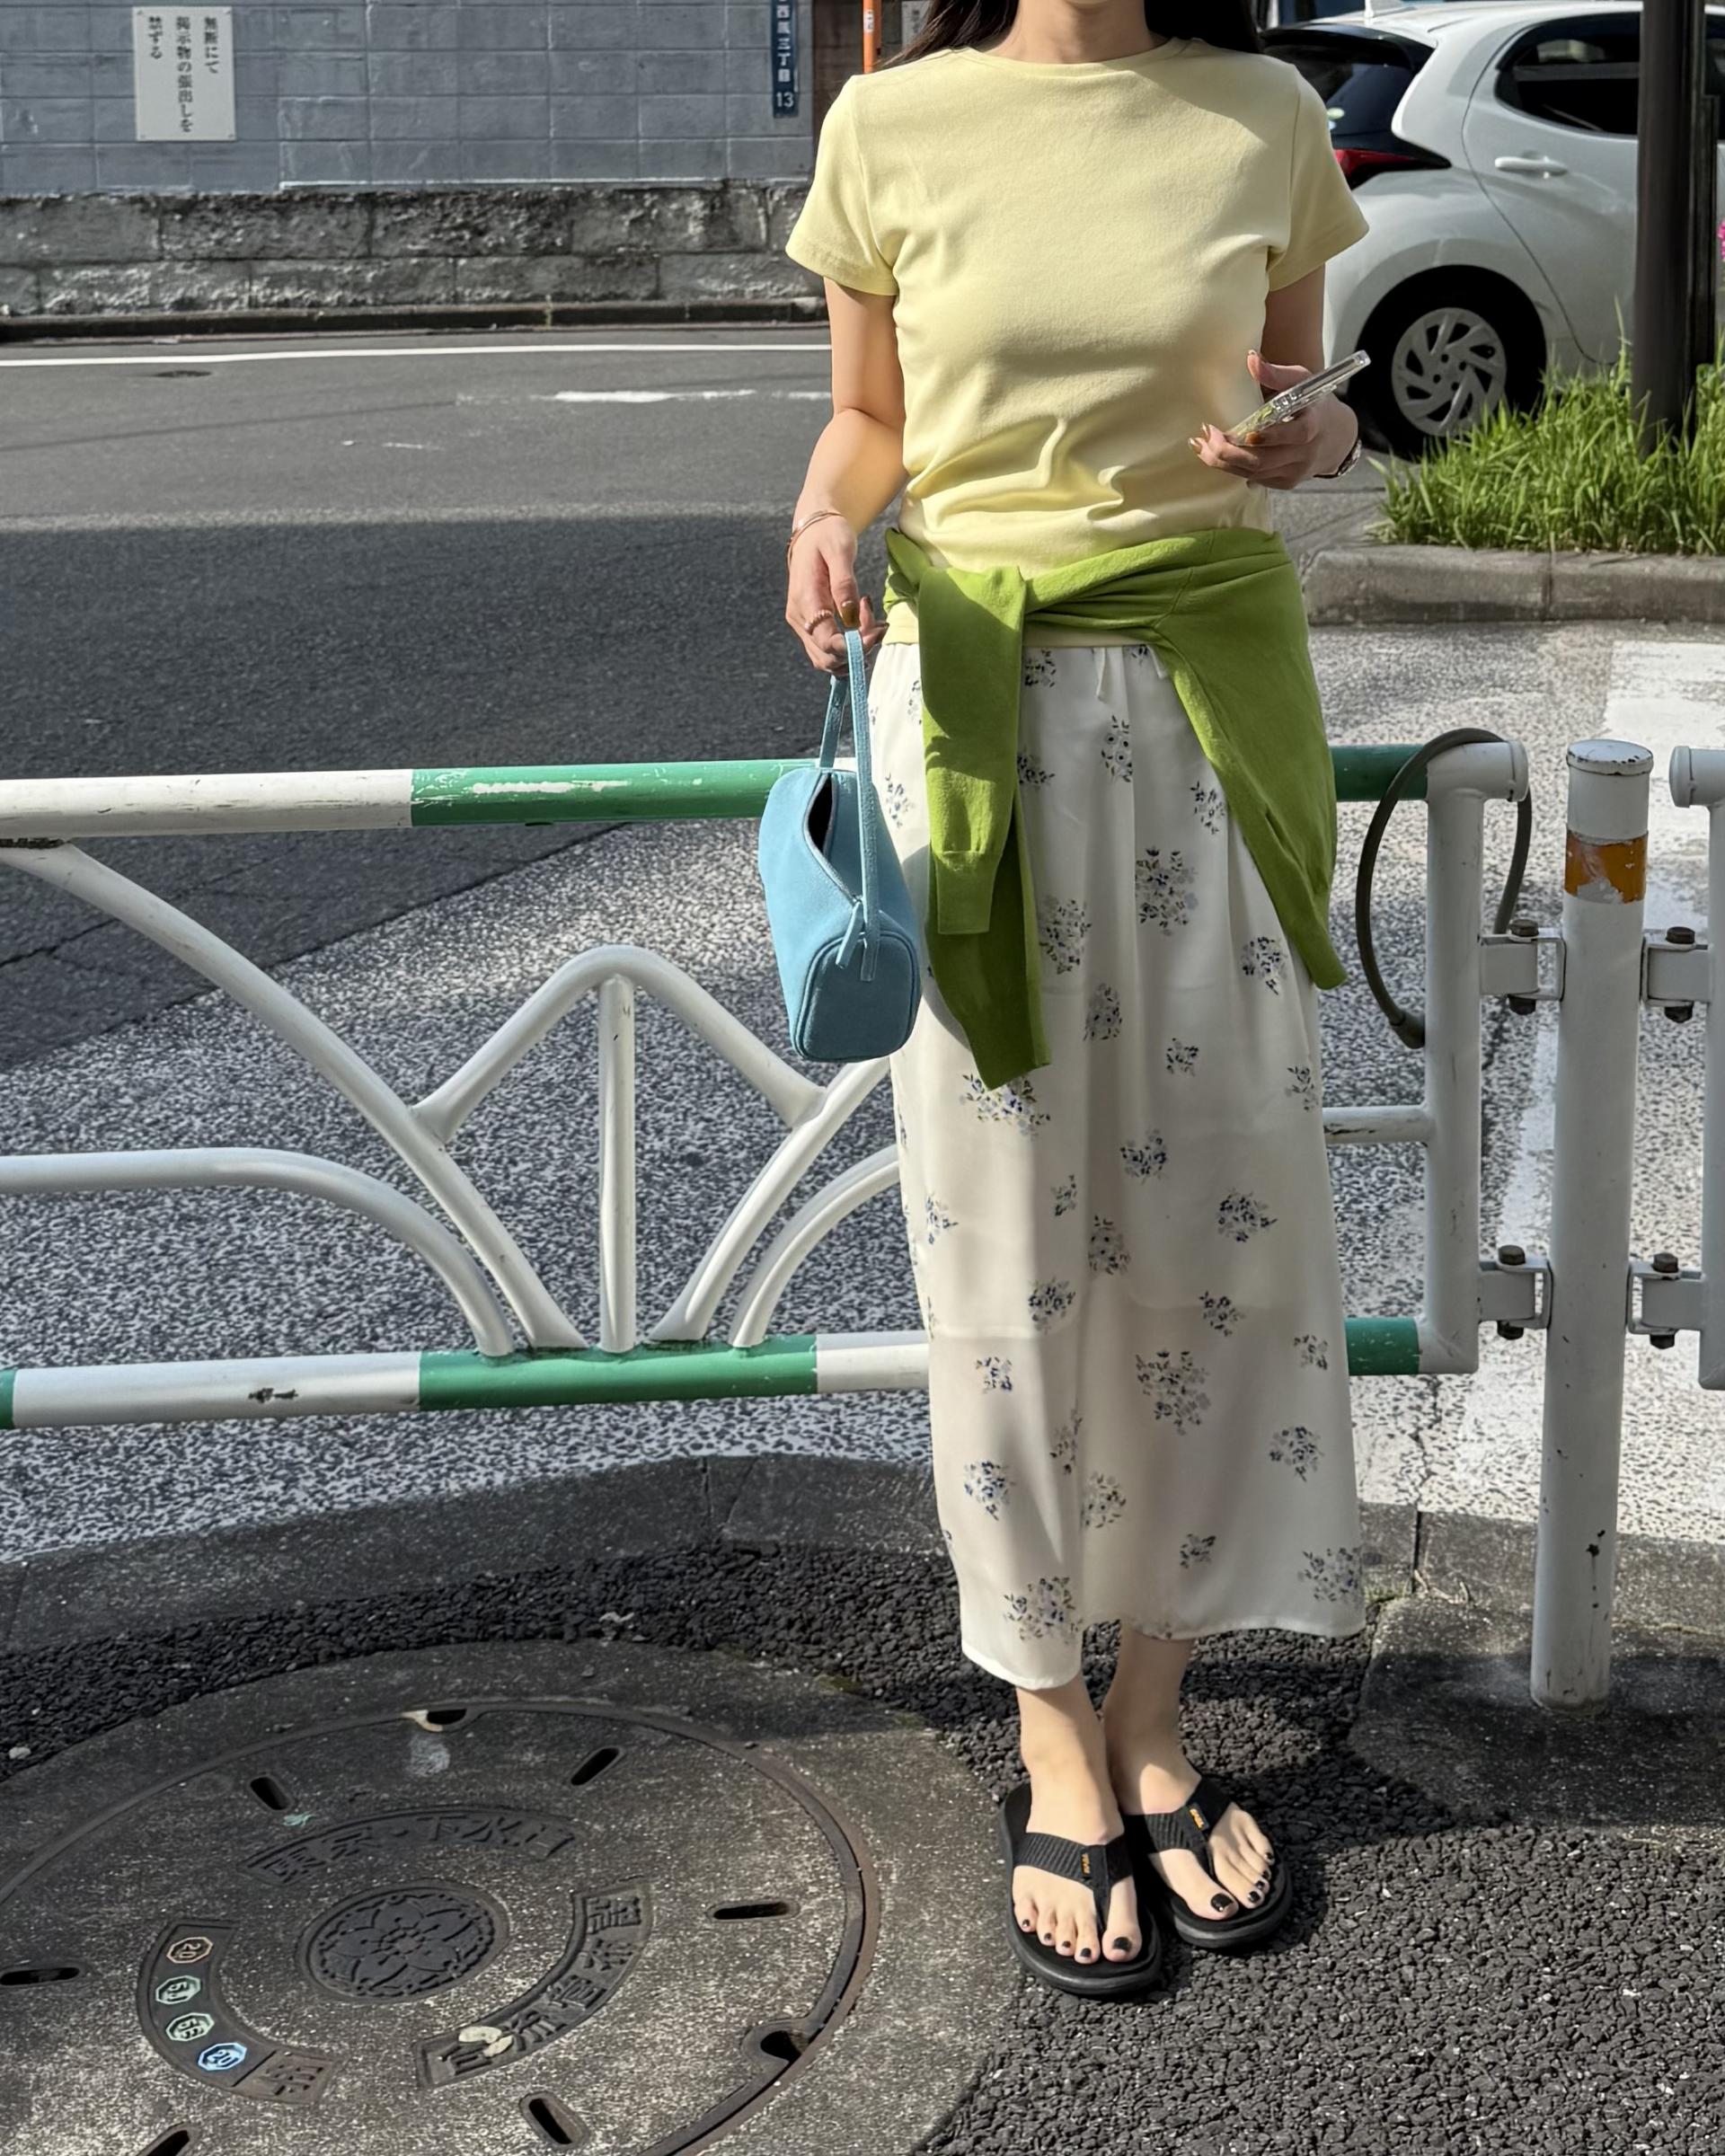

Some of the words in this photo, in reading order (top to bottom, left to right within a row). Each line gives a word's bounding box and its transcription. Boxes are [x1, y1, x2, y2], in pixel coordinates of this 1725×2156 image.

[148, 15, 164, 60] 禁ずる
[204, 16, 220, 74] 無断にて
[776, 0, 792, 83] 西原三丁目
[775, 93, 794, 108] 13
[207, 2048, 234, 2067] 20
